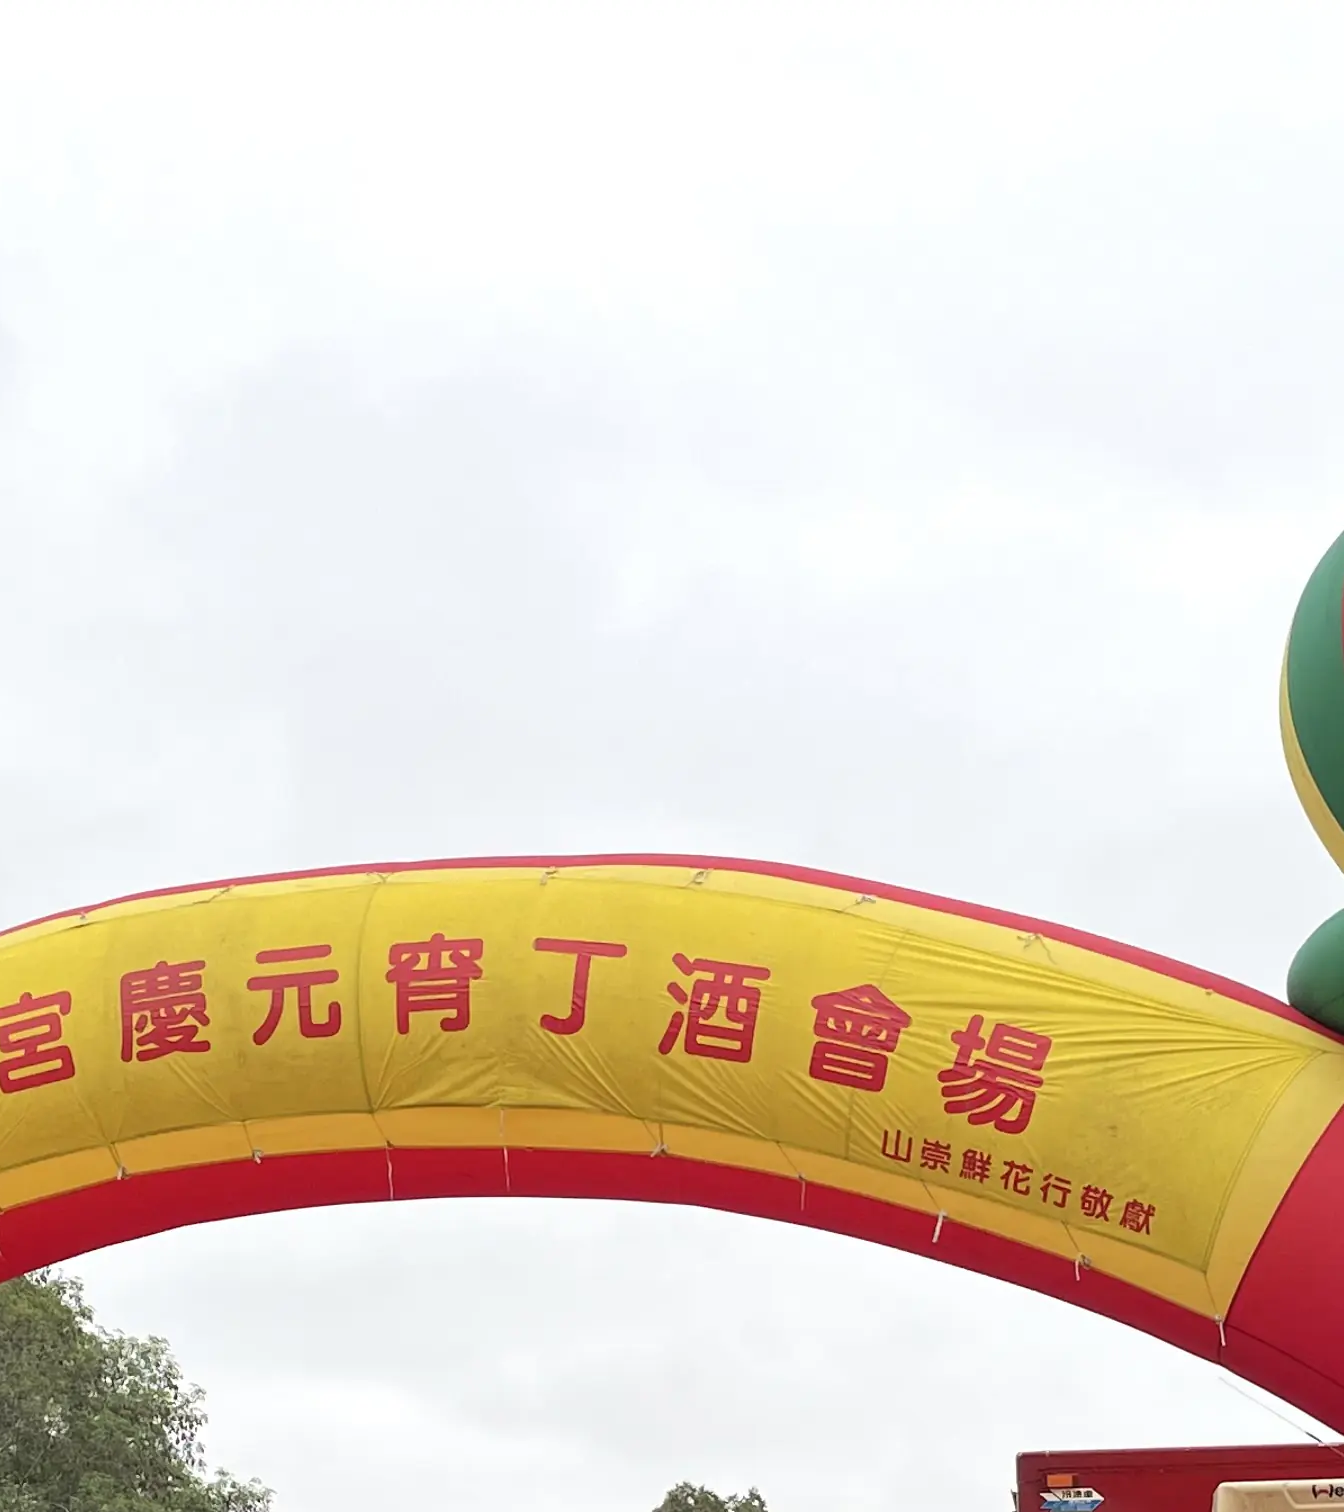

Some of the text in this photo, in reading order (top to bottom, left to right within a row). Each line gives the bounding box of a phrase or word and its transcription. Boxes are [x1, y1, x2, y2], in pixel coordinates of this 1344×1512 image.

[881, 1129, 1156, 1235] 山崇鮮花行敬獻
